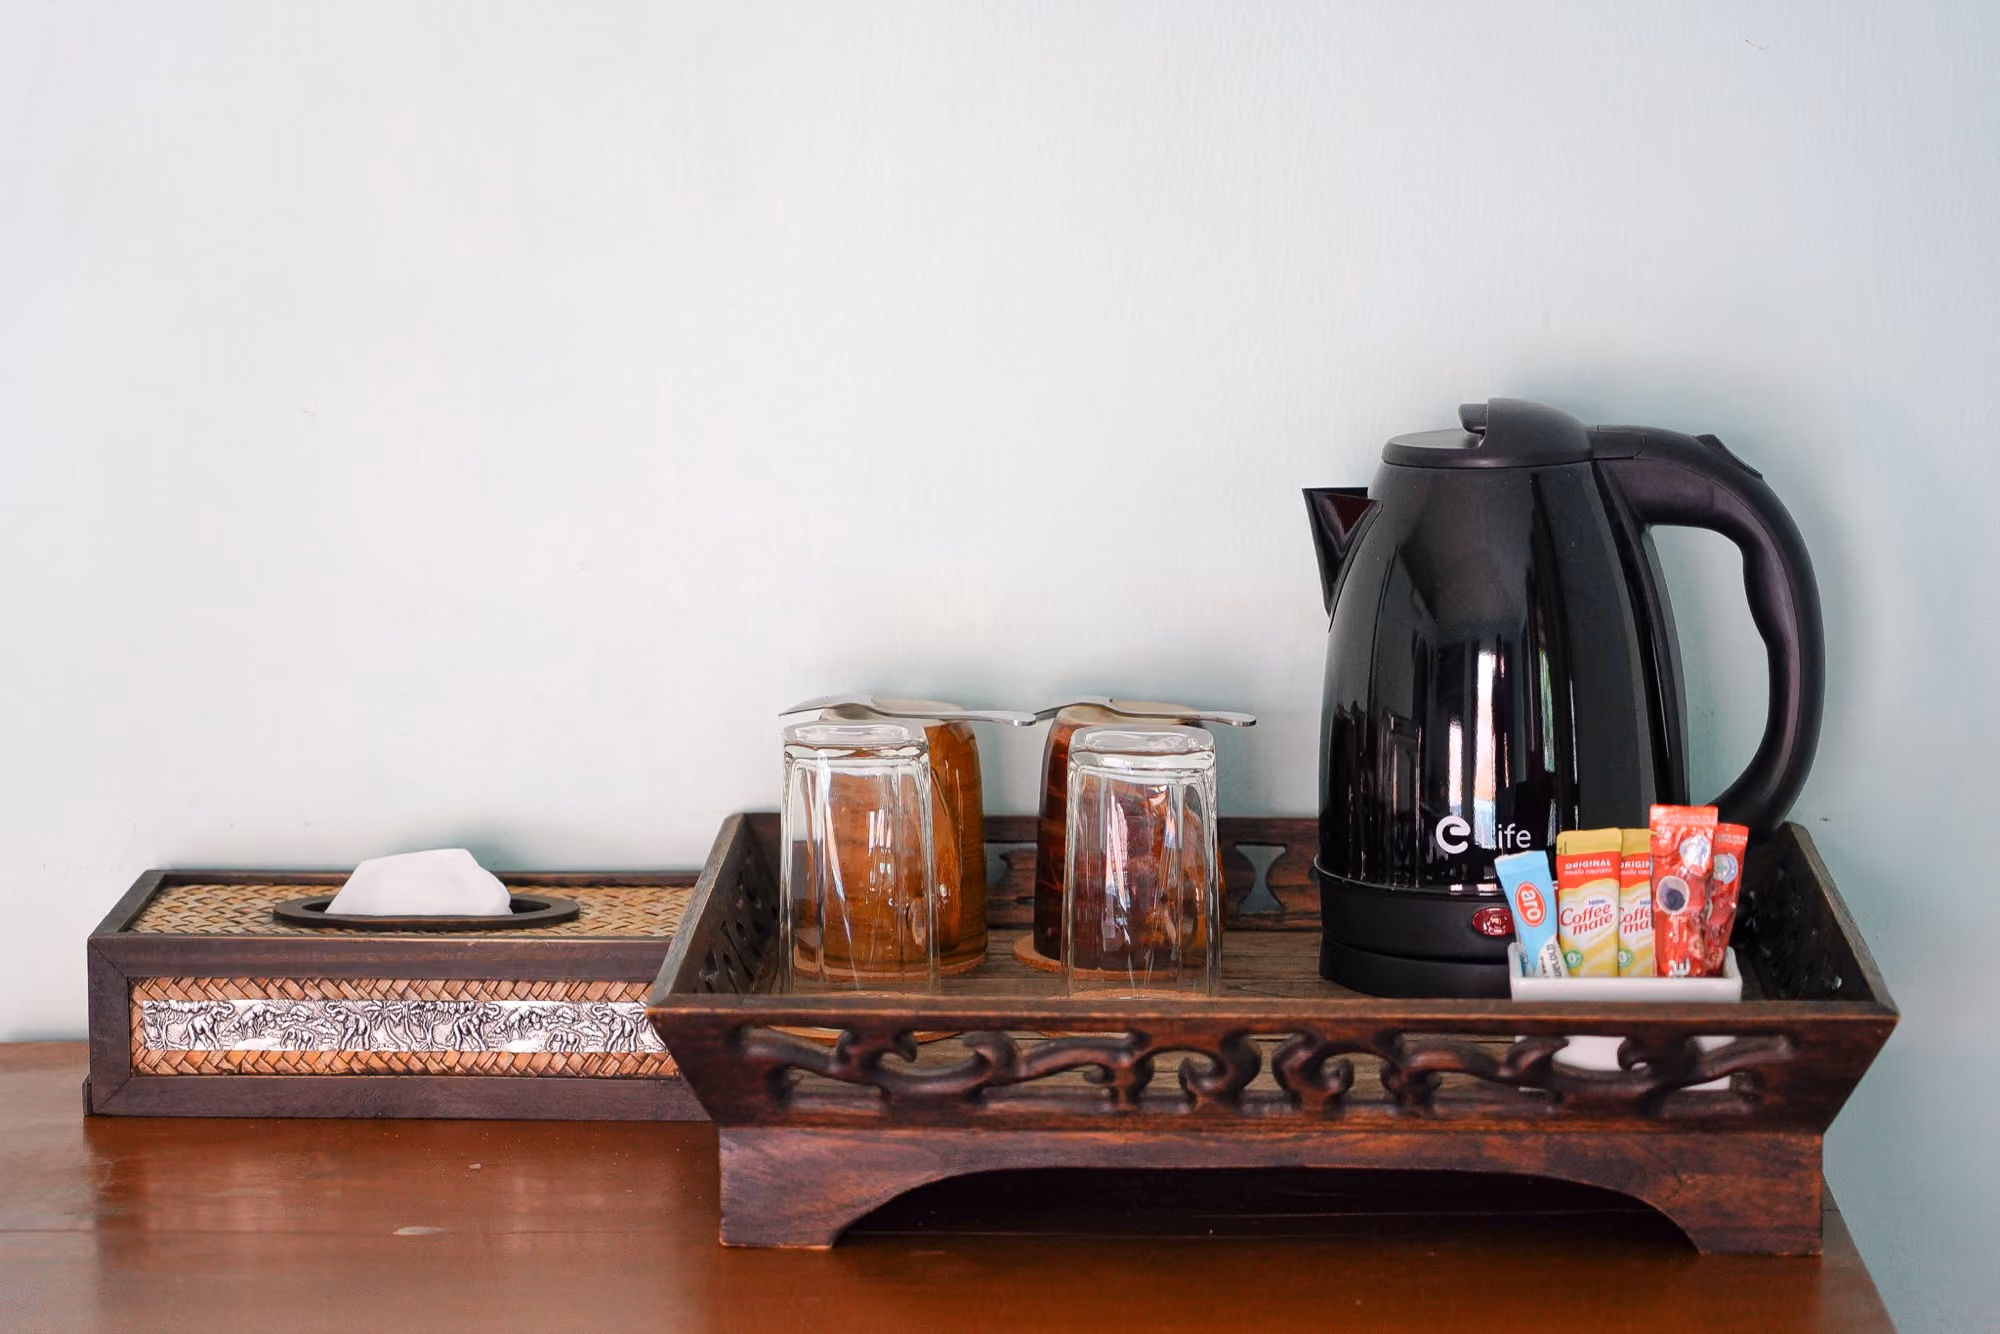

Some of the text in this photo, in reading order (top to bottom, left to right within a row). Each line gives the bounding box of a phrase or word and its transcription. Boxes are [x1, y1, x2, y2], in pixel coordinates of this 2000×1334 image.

[1565, 859, 1612, 870] ORIGINAL
[1520, 889, 1542, 921] aro
[1560, 904, 1611, 926] Coffee
[1573, 914, 1613, 935] mate
